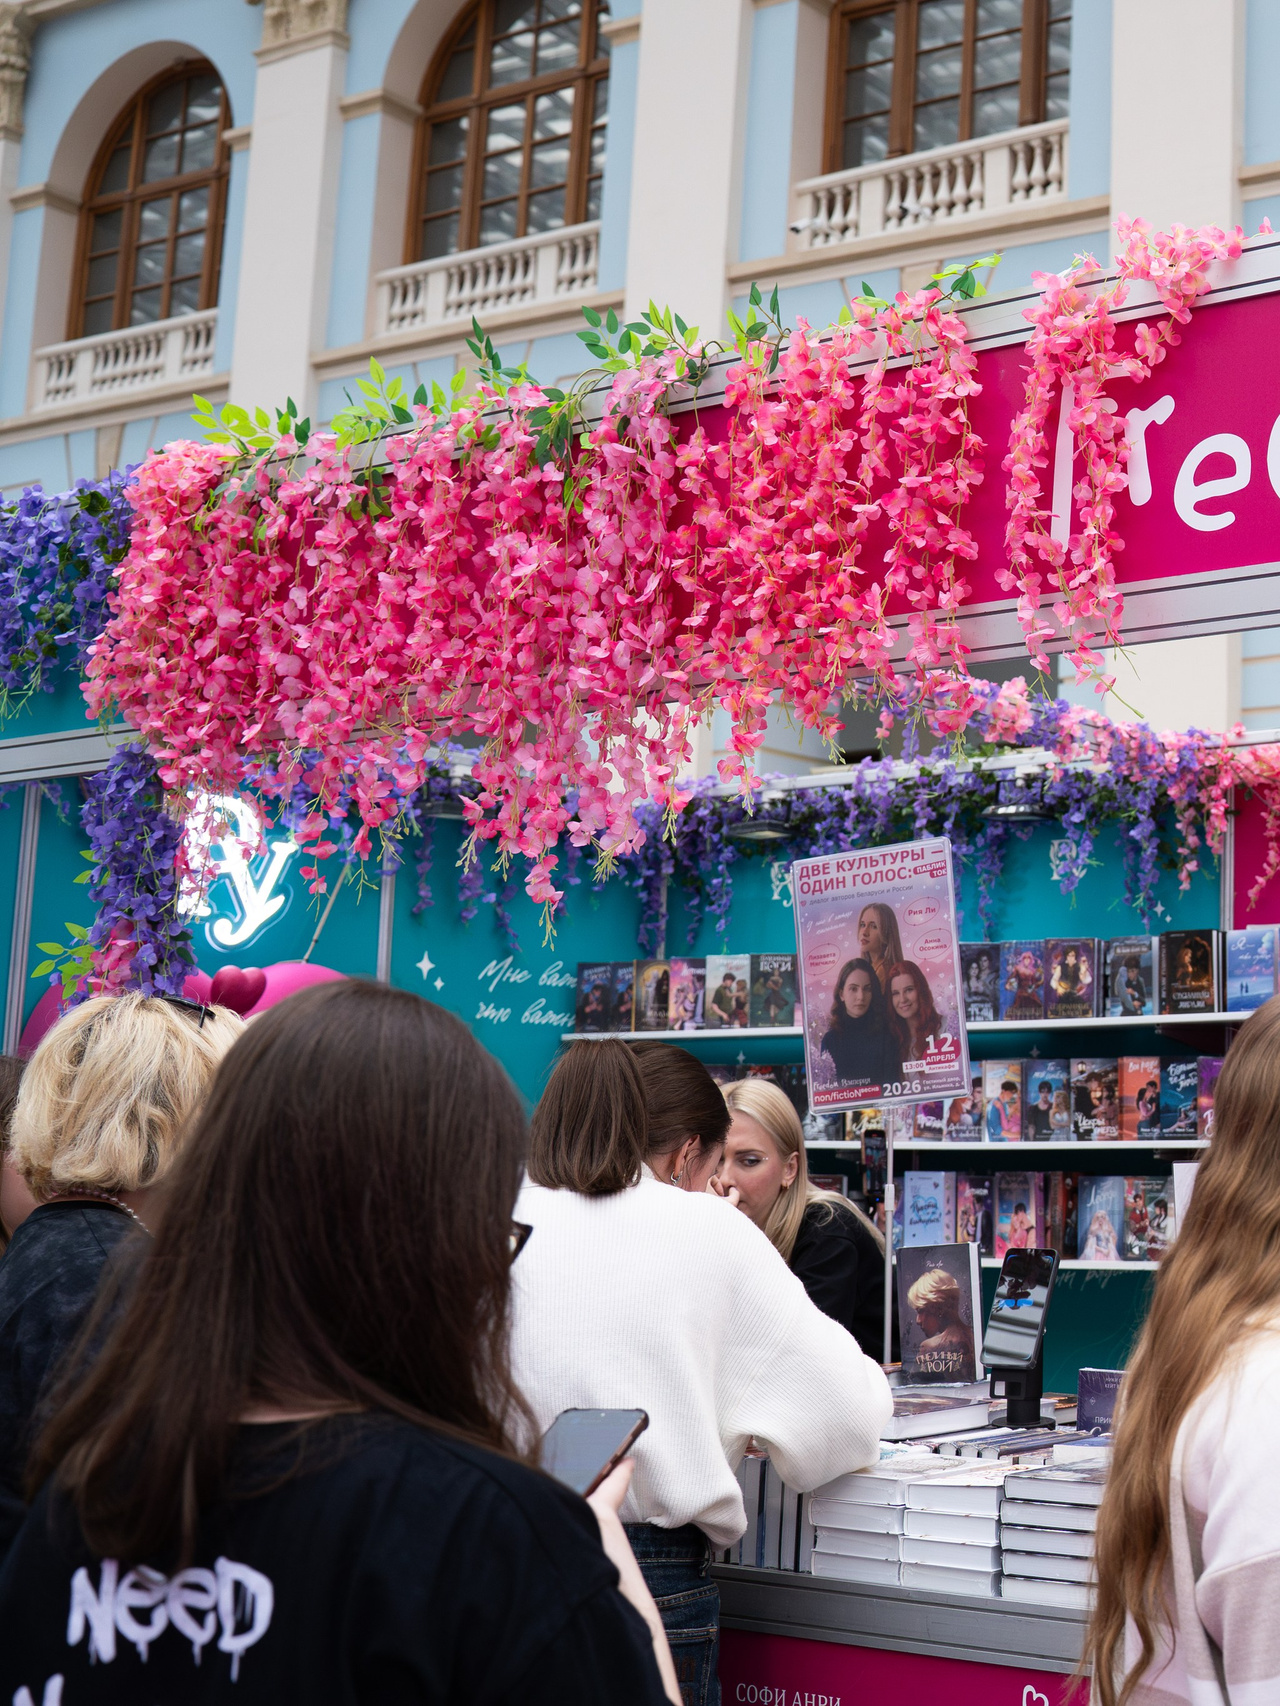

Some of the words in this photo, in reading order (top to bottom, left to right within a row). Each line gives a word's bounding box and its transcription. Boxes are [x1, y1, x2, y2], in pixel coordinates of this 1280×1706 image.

[799, 860, 833, 881] ДВЕ
[836, 847, 925, 875] КУЛЬТУРЫ
[800, 876, 850, 896] ОДИН
[853, 866, 913, 891] ГОЛОС:
[908, 907, 923, 918] Рия
[925, 905, 936, 916] Ли
[918, 942, 948, 954] Осокина
[924, 936, 941, 947] Анна
[478, 955, 532, 992] Мне
[925, 1033, 955, 1055] 12
[926, 1053, 956, 1064] АПРЕЛЯ
[904, 1061, 925, 1071] 13:00
[883, 1080, 921, 1096] 2026
[927, 1360, 953, 1373] РОЙ
[736, 1683, 786, 1706] СОФИ
[793, 1690, 841, 1706] АНРИ
